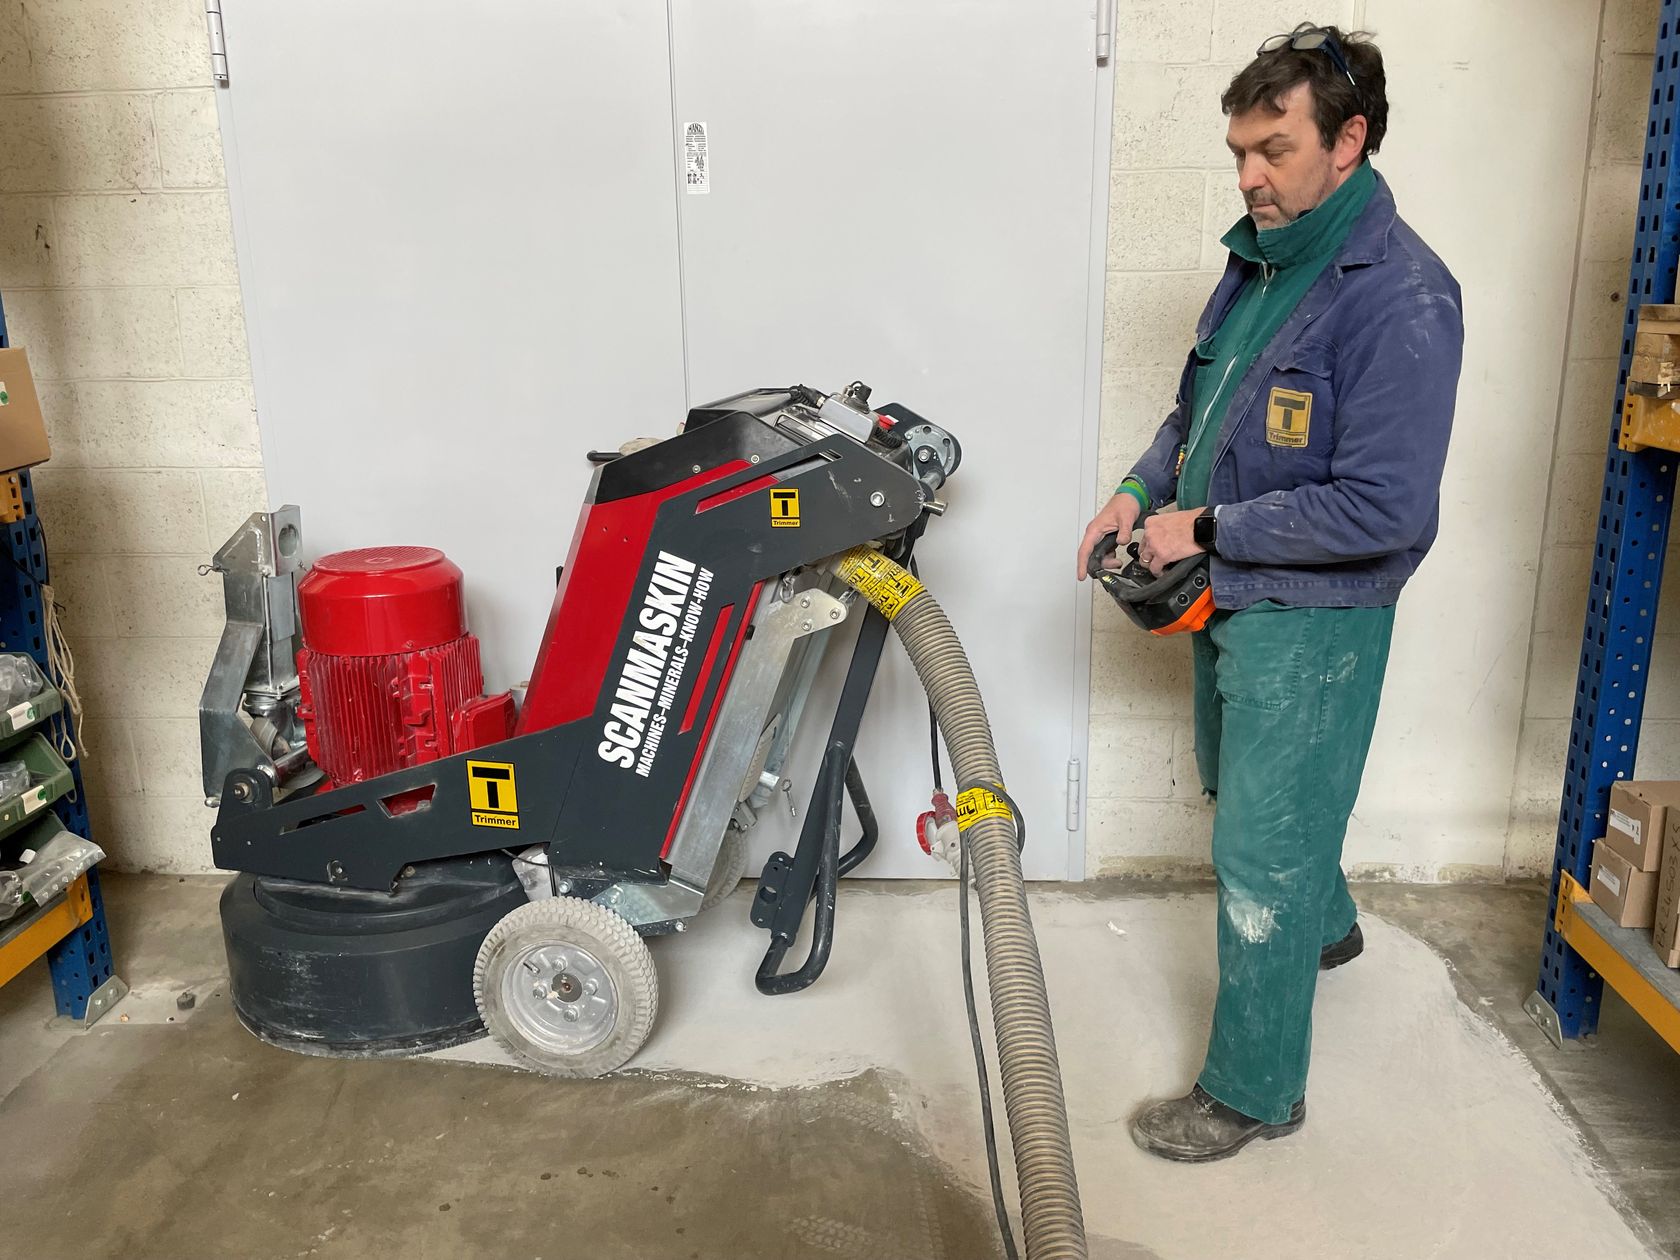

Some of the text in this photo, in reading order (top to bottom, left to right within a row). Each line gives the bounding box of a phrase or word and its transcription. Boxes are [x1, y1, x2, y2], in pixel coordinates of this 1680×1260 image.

[1274, 396, 1306, 430] T
[1269, 431, 1304, 443] Trimmer
[773, 492, 796, 516] T
[597, 550, 697, 769] SCANMASKIN
[472, 766, 510, 808] T
[475, 814, 517, 826] Trimmer
